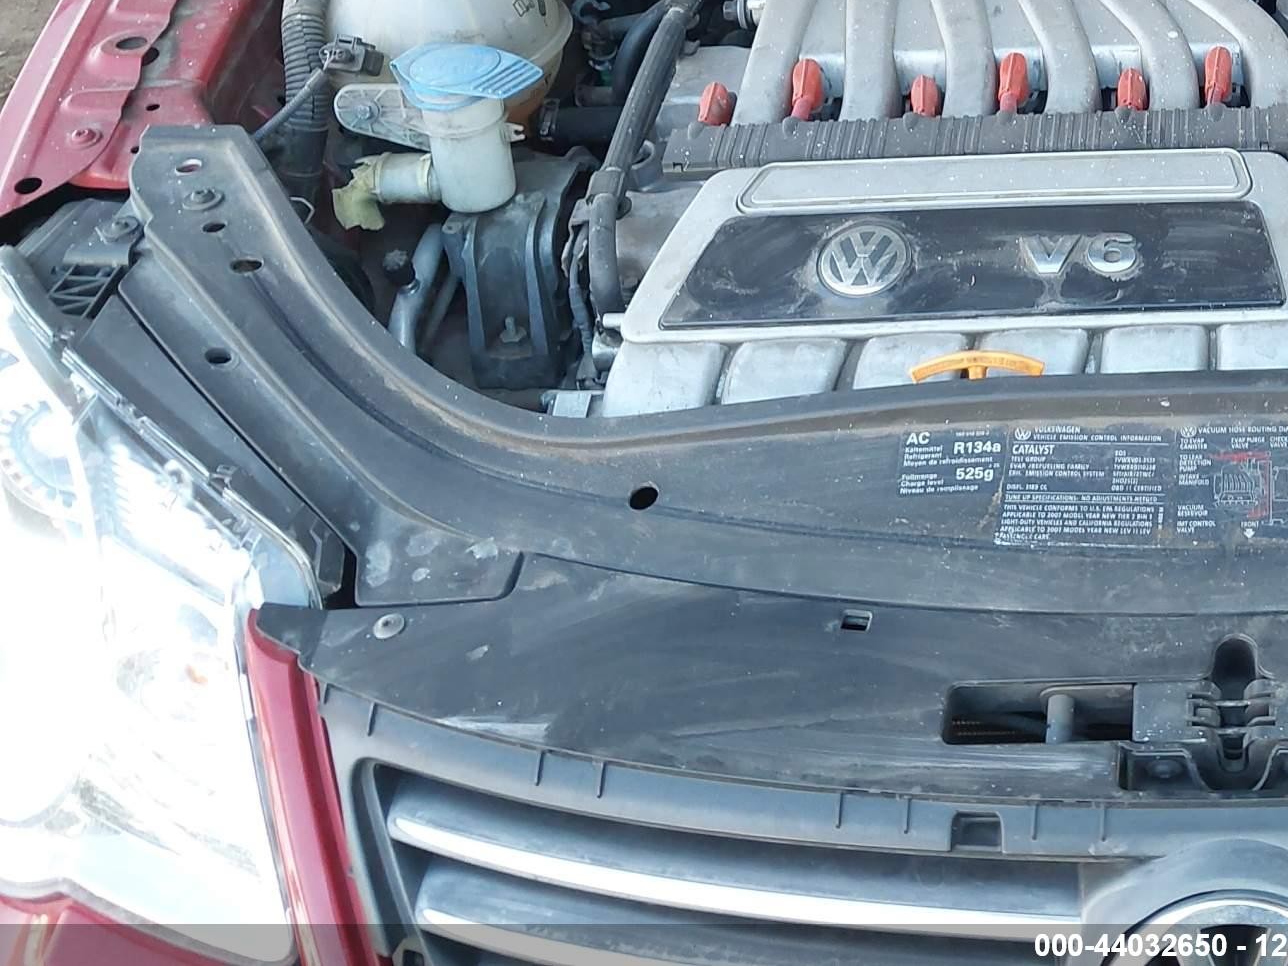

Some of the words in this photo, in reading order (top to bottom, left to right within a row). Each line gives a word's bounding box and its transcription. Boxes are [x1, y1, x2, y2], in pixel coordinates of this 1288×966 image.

[1019, 233, 1138, 274] V6
[906, 432, 930, 445] AC
[954, 441, 1002, 454] R134a
[1012, 444, 1055, 455] CATALYST
[904, 452, 942, 461] Refrigerant
[956, 468, 994, 481] 525g
[900, 480, 925, 488] Charge
[937, 484, 978, 492] remplissage
